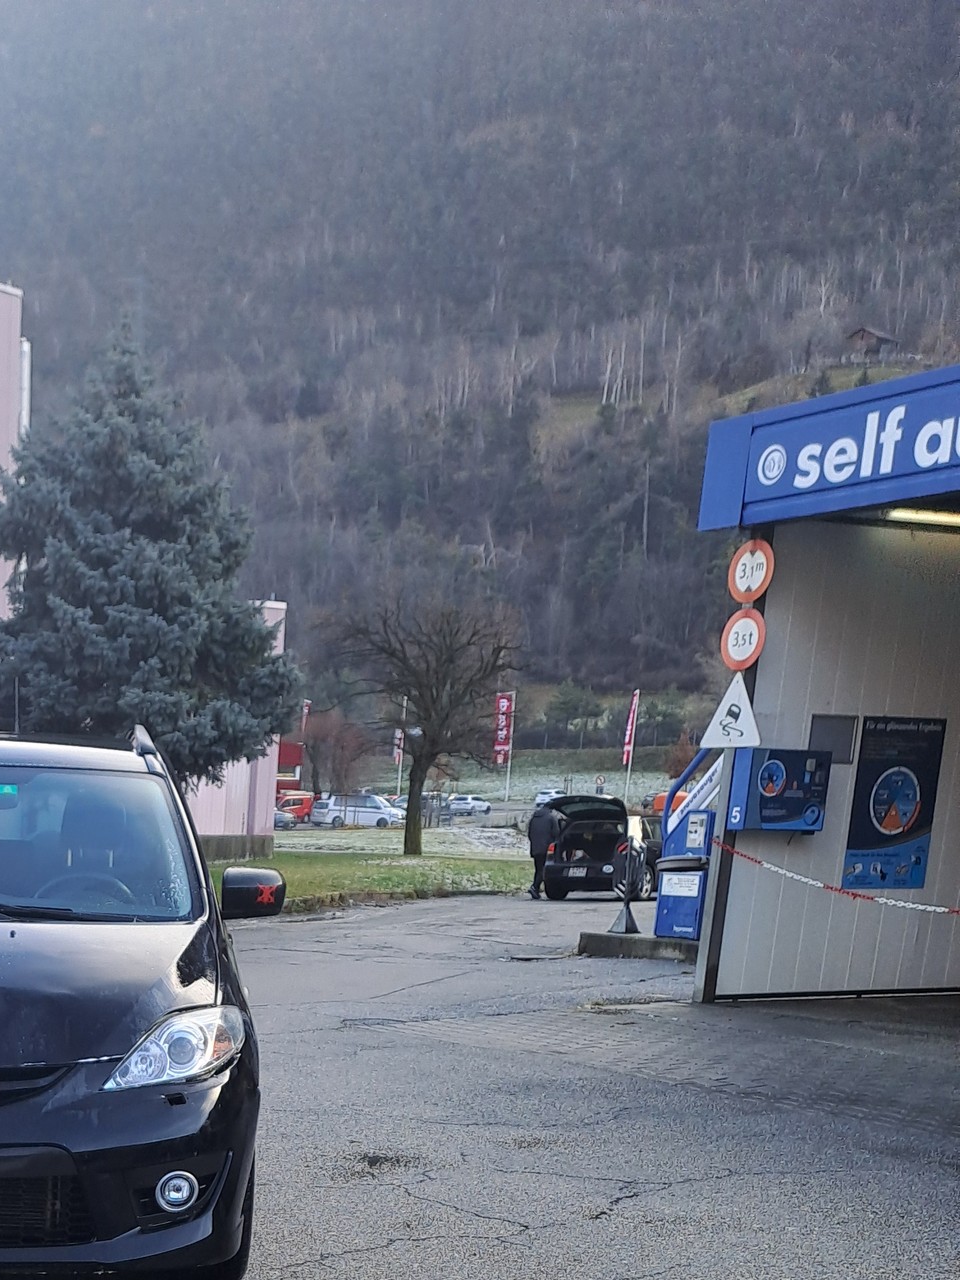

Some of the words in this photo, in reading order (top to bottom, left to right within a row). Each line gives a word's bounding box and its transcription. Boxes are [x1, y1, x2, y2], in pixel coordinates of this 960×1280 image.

[793, 405, 906, 489] self
[913, 416, 960, 468] a
[730, 806, 741, 824] 5
